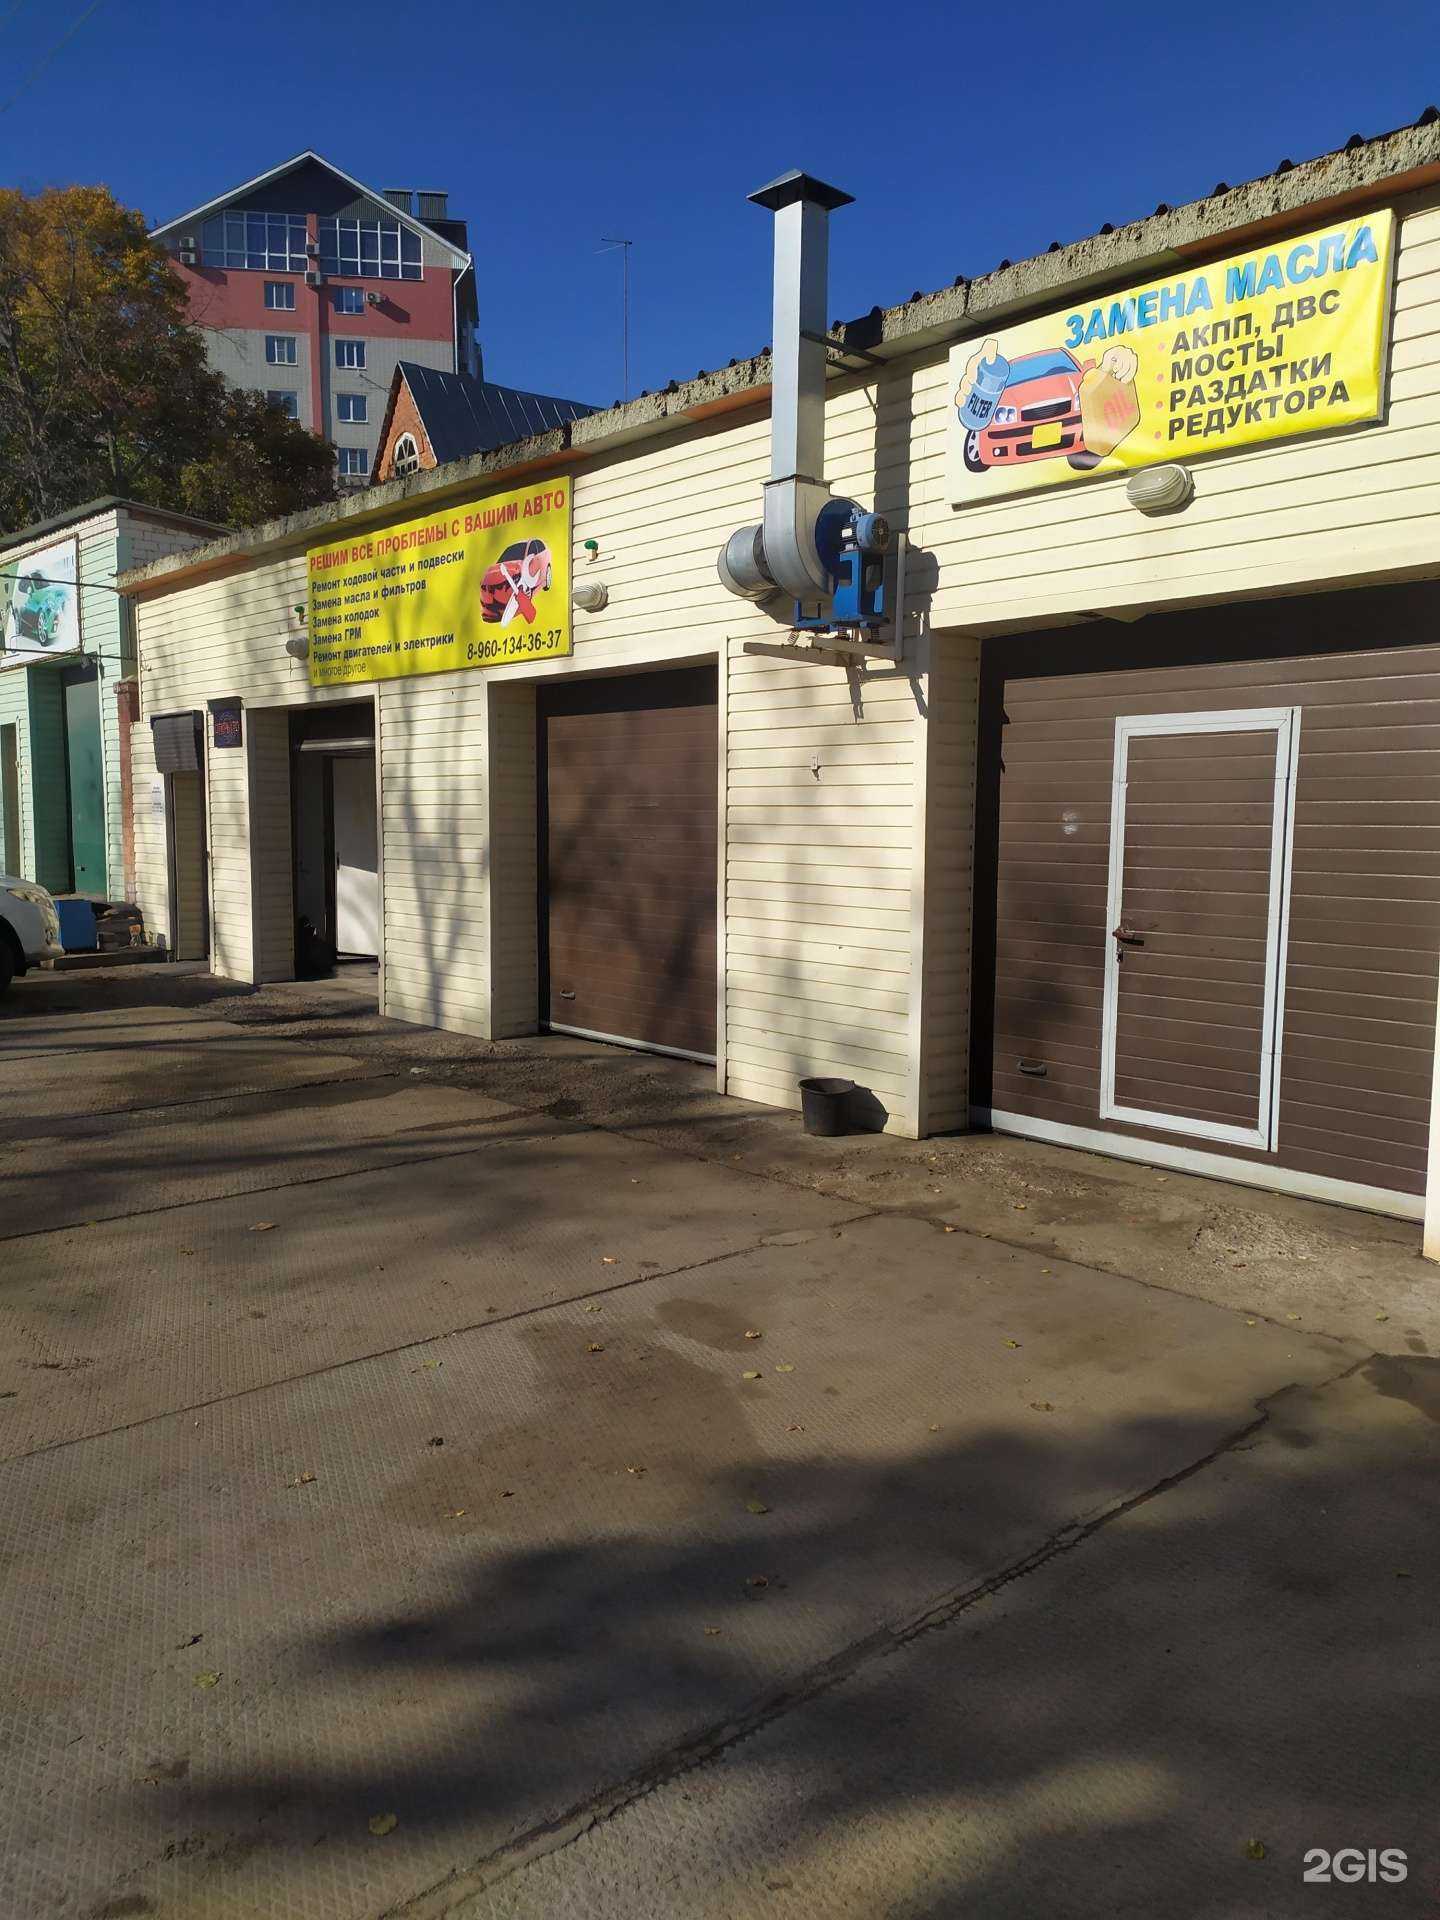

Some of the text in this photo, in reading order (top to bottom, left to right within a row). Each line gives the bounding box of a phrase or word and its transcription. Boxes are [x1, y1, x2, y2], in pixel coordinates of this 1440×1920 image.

[1065, 226, 1379, 349] ЗАМЕНА МАСЛА
[1172, 290, 1340, 353] АКПП, ДВС
[1171, 334, 1283, 383] МОСТЫ
[1169, 353, 1332, 412] РАЗДАТКИ
[968, 389, 993, 418] FILTER
[1168, 381, 1349, 440] РЕДУКТОРА
[311, 490, 564, 571] РЕШИМ ВСЕ ПРОБЛЕМЫ С ВАШИМ АВТО
[312, 549, 464, 593] Ремонт ходовой части и подвески
[312, 580, 426, 610] Замена масла и фильтров
[312, 609, 379, 628] Замена колодок
[313, 626, 361, 645] Замена ГРМ
[313, 632, 454, 662] Ремонт двигателей и электрики
[467, 630, 561, 659] 8-960-134-36-37
[343, 662, 366, 676] другое
